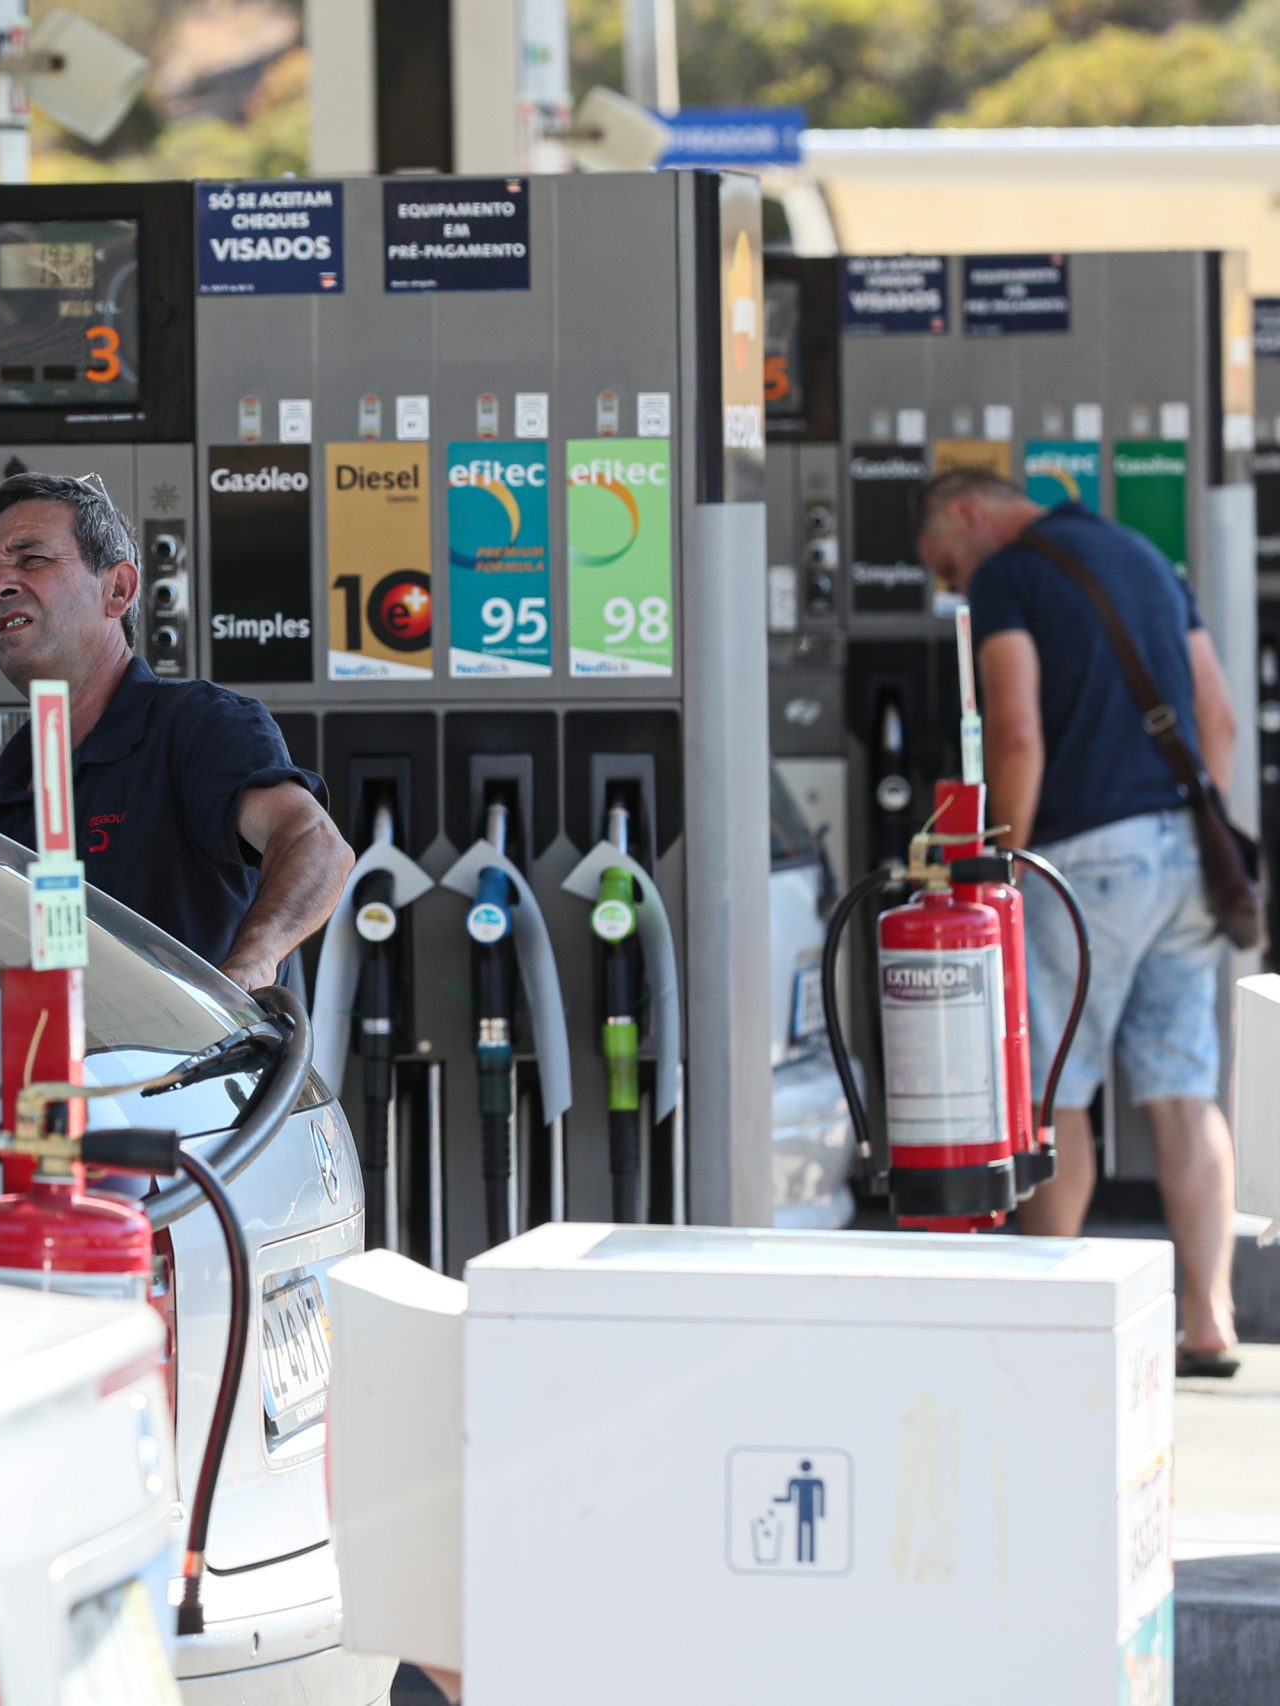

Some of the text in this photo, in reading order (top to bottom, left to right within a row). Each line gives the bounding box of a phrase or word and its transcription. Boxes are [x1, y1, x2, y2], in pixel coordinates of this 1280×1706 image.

[208, 187, 333, 210] SÓ SE ACEITAM
[398, 202, 516, 219] EQUIPAMENTO
[231, 212, 310, 231] CHEQUES
[443, 223, 470, 239] EM
[210, 235, 332, 262] VISADOS
[388, 242, 526, 260] PRÉ-PAGAMENTO
[84, 325, 121, 383] 3
[763, 355, 790, 400] 5
[210, 466, 308, 493] Gasóleo
[336, 463, 419, 491] Diesel
[450, 460, 545, 488] efitec
[571, 459, 666, 486] efitec
[476, 547, 544, 557] PREMIUM
[475, 562, 544, 573] FORMULA
[211, 612, 311, 645] Simples
[481, 597, 548, 644] 95
[603, 596, 669, 644] 98
[886, 967, 969, 987] EXTINTOR
